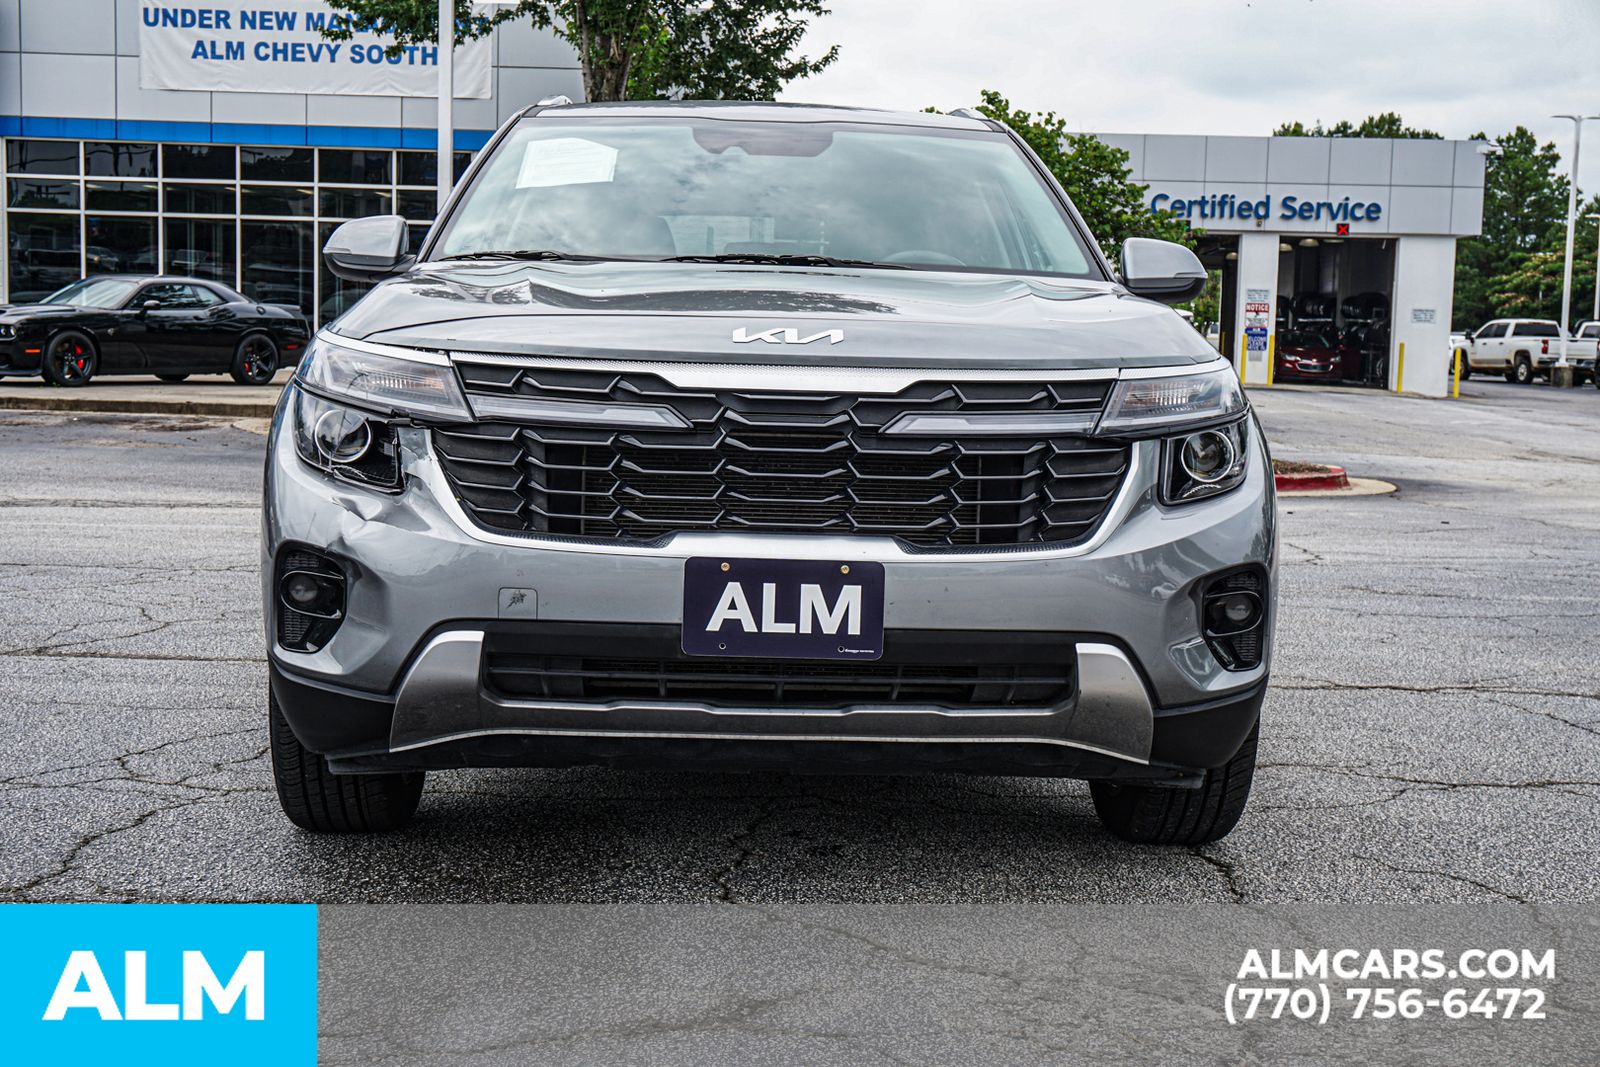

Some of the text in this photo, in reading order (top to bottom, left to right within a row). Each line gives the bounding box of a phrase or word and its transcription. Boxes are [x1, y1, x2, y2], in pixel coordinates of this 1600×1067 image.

[143, 7, 231, 30] UNDER
[240, 10, 297, 31] NEW
[191, 40, 245, 61] ALM
[253, 41, 342, 63] CHEVY
[1151, 193, 1382, 222] Certified Service
[1246, 303, 1269, 312] NOTICE
[732, 327, 844, 346] KIA
[705, 581, 862, 636] ALM
